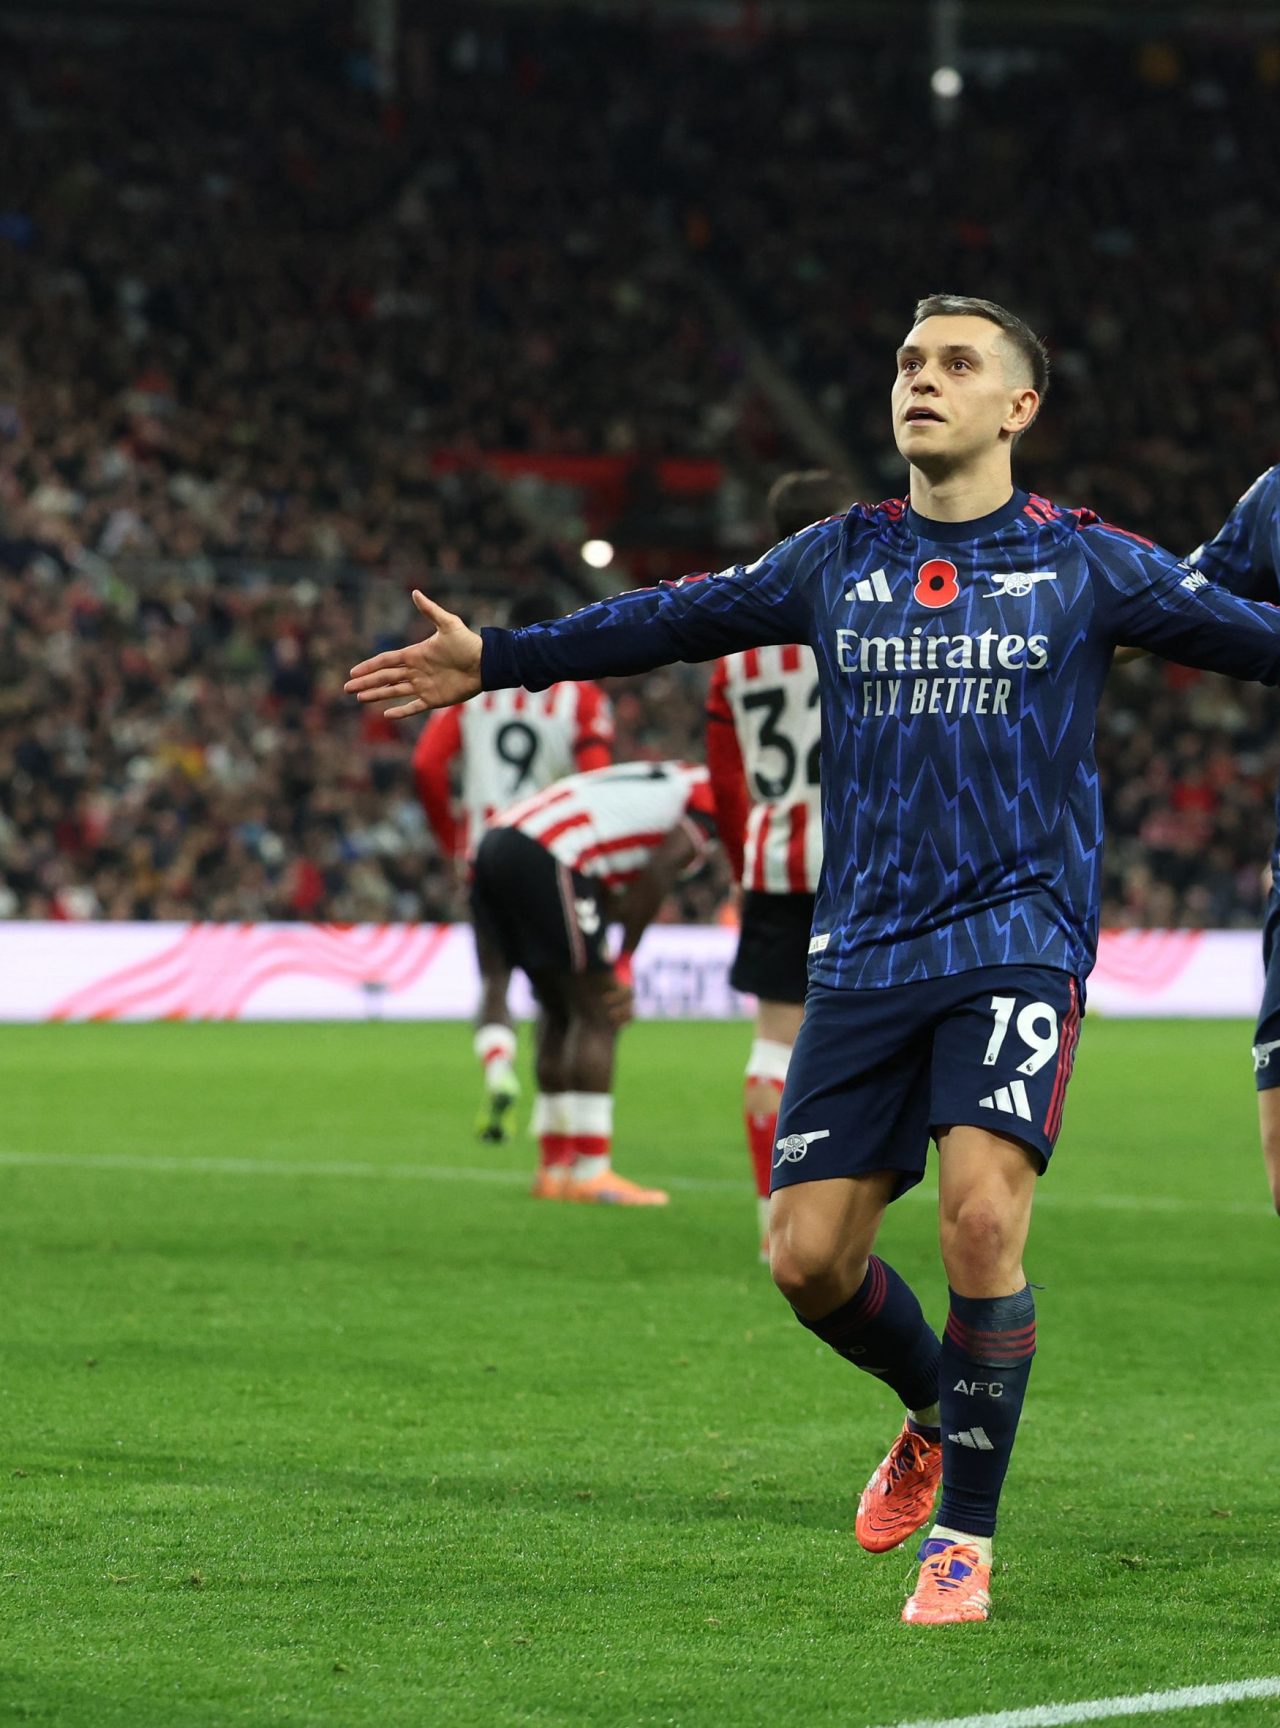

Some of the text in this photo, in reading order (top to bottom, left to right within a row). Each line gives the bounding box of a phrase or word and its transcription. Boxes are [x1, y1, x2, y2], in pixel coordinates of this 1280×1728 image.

[835, 627, 1049, 673] Emirates
[862, 678, 1012, 717] FLY BETTER
[495, 720, 540, 796] 9
[982, 996, 1059, 1077] 19
[953, 1379, 1005, 1398] AFC
